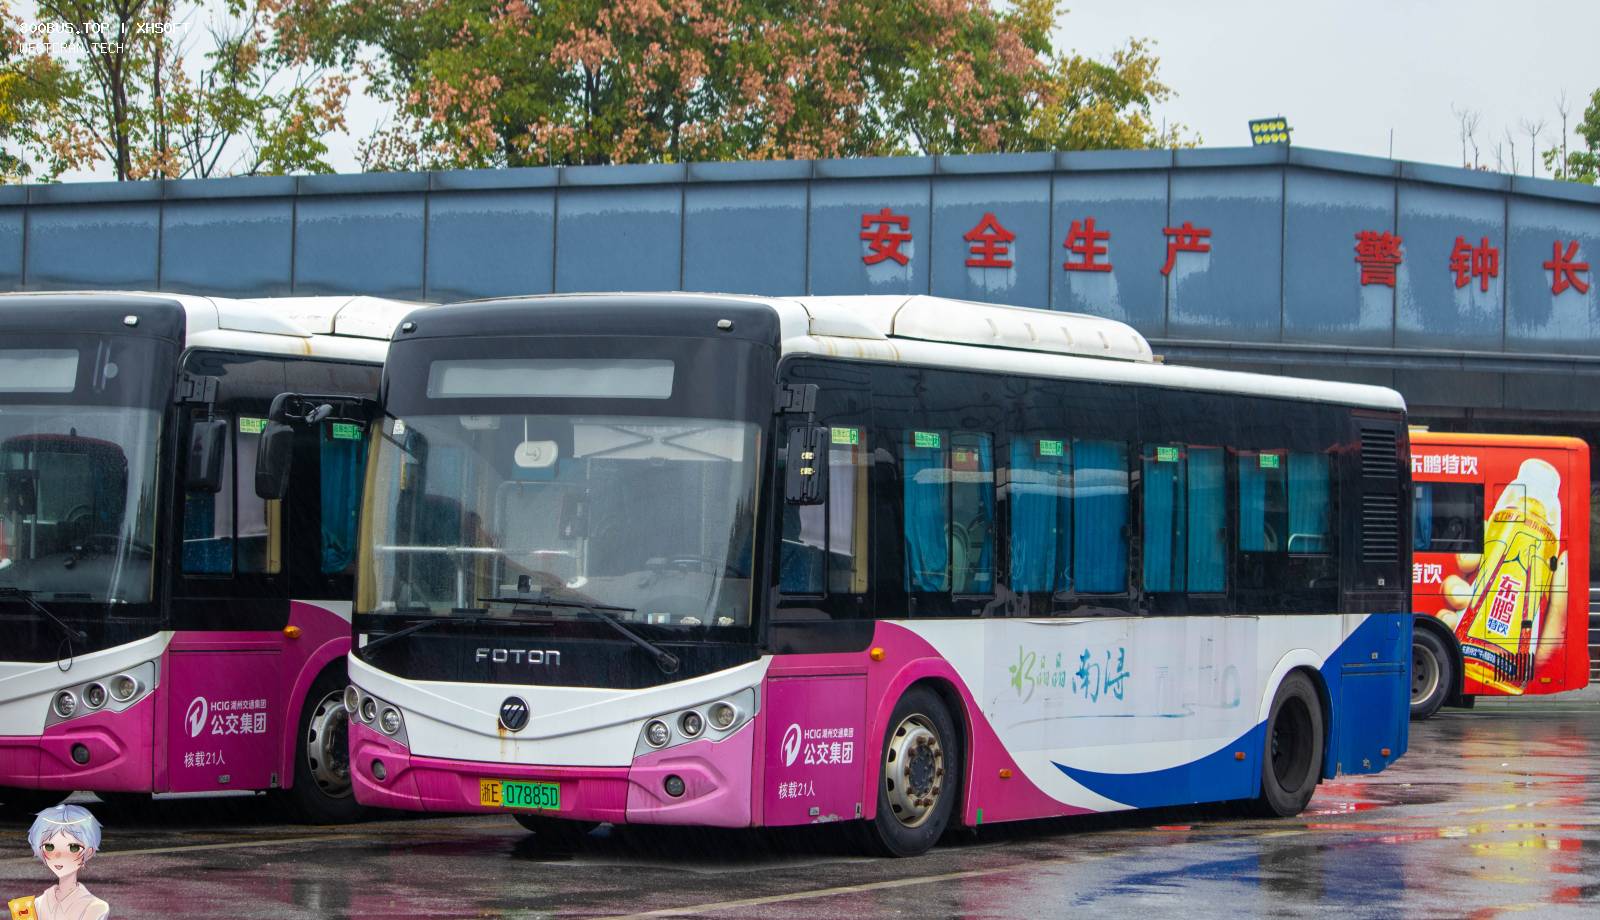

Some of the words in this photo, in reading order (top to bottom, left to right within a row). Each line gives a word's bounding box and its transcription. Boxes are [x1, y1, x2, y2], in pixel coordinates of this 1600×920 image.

[860, 208, 1212, 275] 安全生产
[1355, 230, 1592, 295] 警钟长
[475, 648, 561, 666] FOTON
[211, 701, 230, 711] HCIG
[211, 713, 267, 735] 公交集团
[804, 729, 822, 739] HCIG
[184, 749, 226, 768] 核载21人
[803, 741, 854, 765] 公交集团
[506, 785, 559, 806] 07885D
[778, 780, 816, 799] 核载21人
